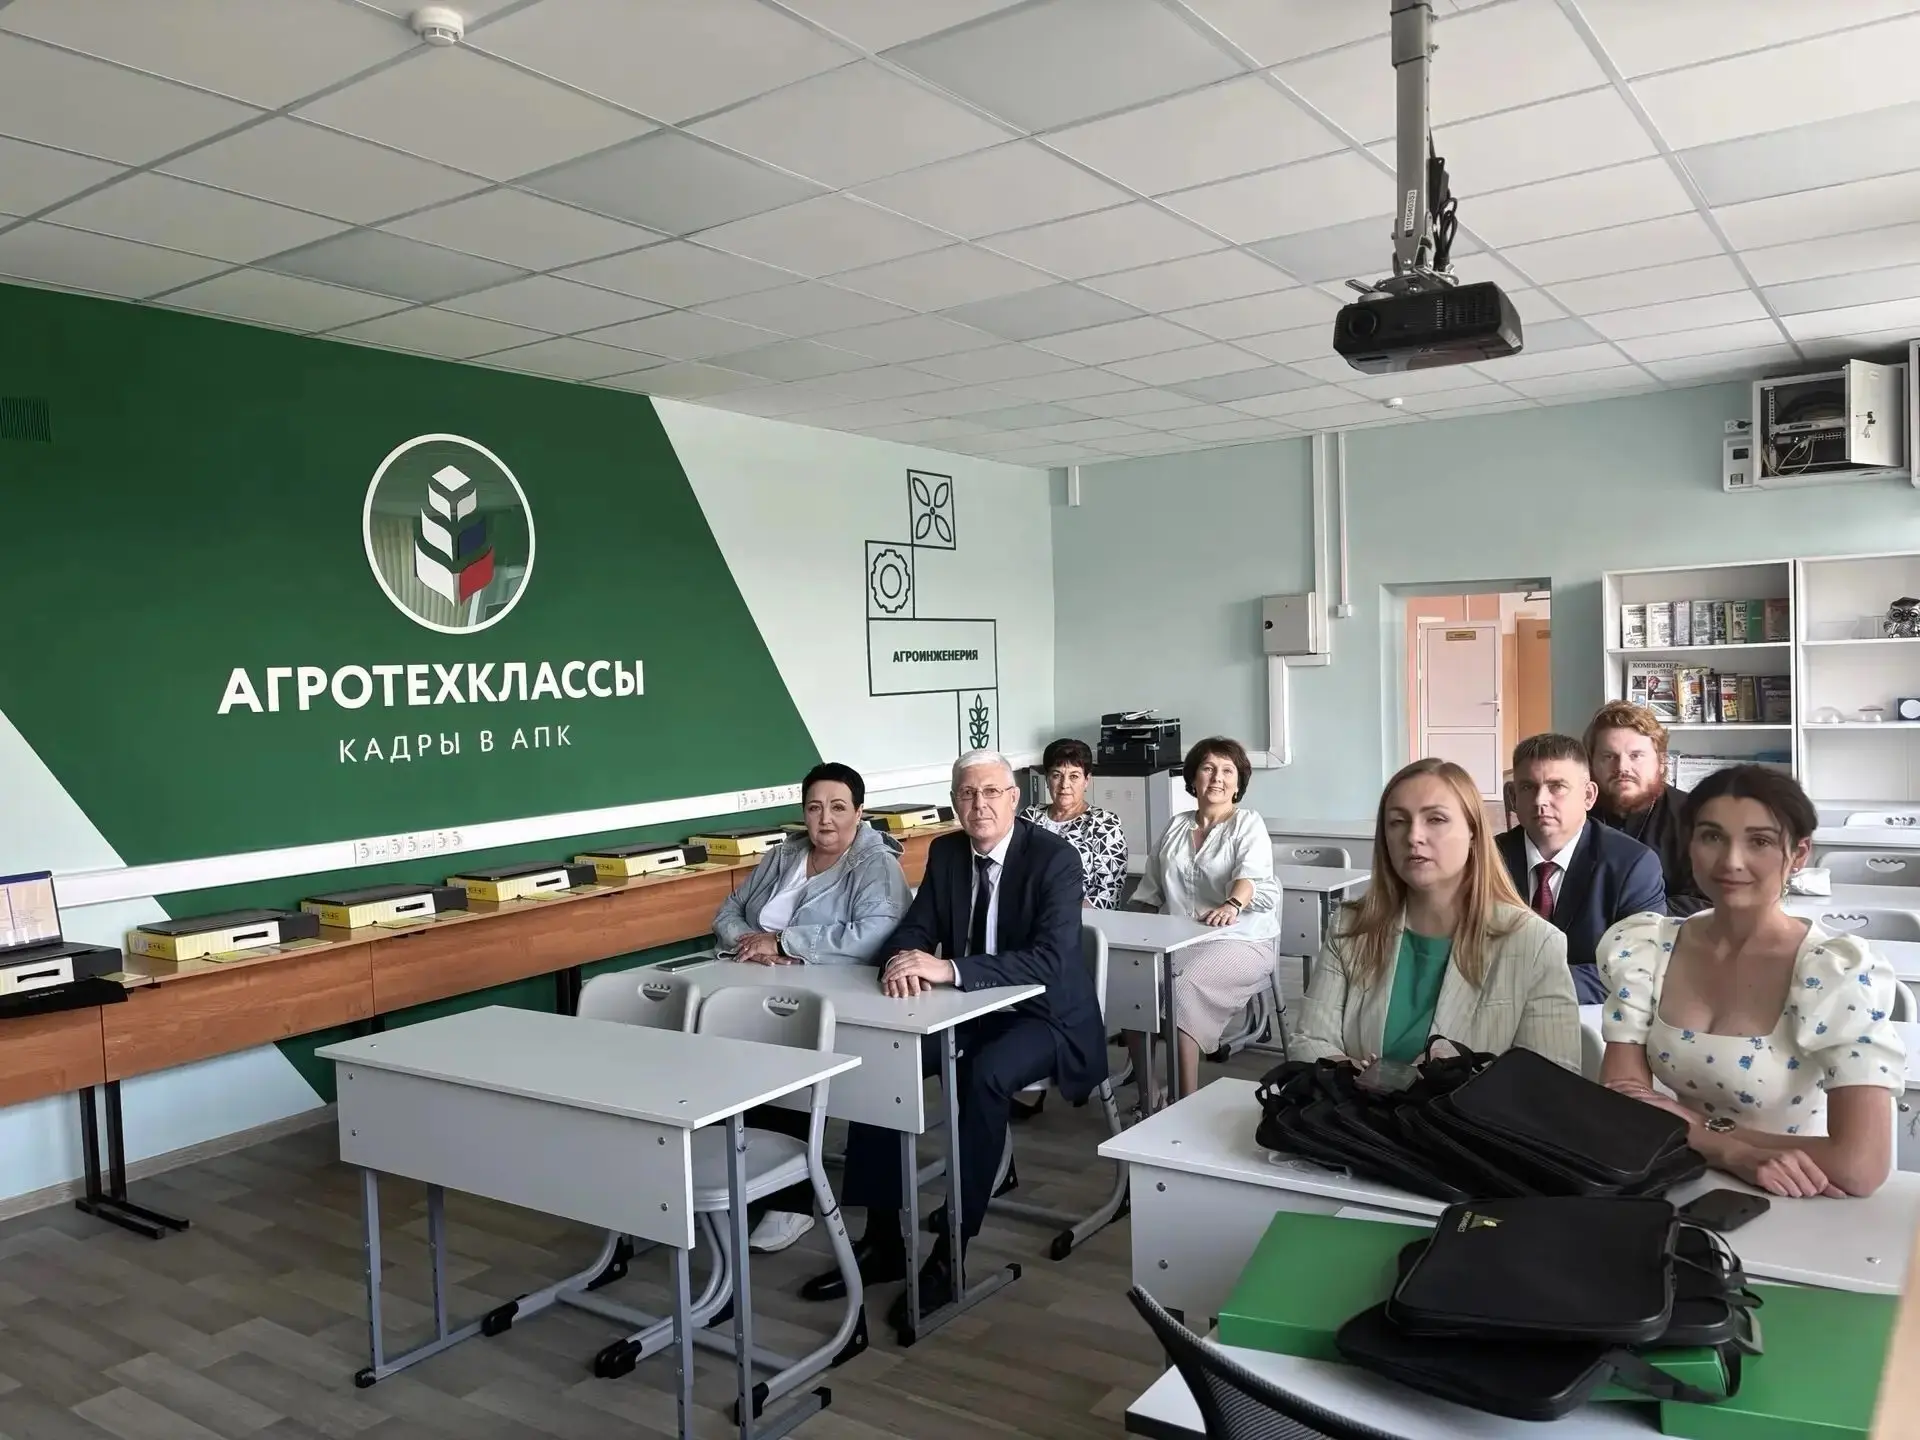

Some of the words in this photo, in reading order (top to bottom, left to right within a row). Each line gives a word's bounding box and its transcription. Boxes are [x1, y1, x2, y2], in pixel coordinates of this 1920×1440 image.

[893, 649, 979, 662] АГРОИНЖЕНЕРИЯ
[217, 660, 646, 715] АГРОТЕХКЛАССЫ
[339, 732, 461, 763] КАДРЫ
[480, 730, 494, 752] В
[511, 725, 573, 750] АПК
